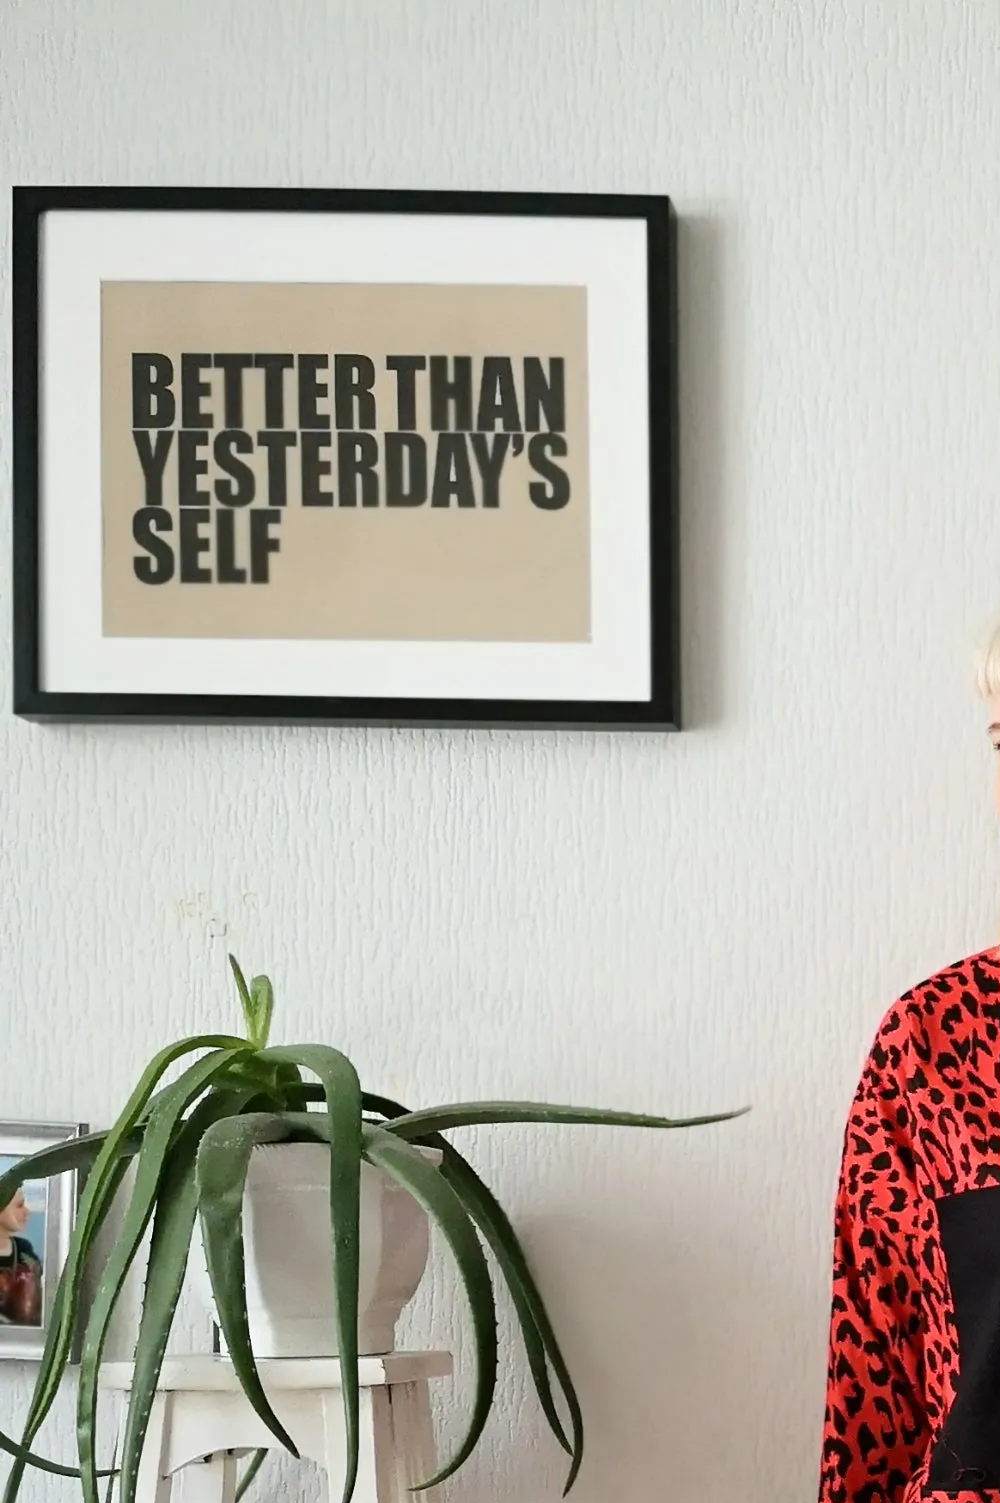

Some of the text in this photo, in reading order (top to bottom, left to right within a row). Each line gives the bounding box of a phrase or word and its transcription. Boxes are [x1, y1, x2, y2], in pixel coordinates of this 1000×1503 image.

[131, 353, 565, 432] BETTER THAN
[132, 430, 571, 510] YESTERDAY'S
[132, 507, 281, 584] SELF
